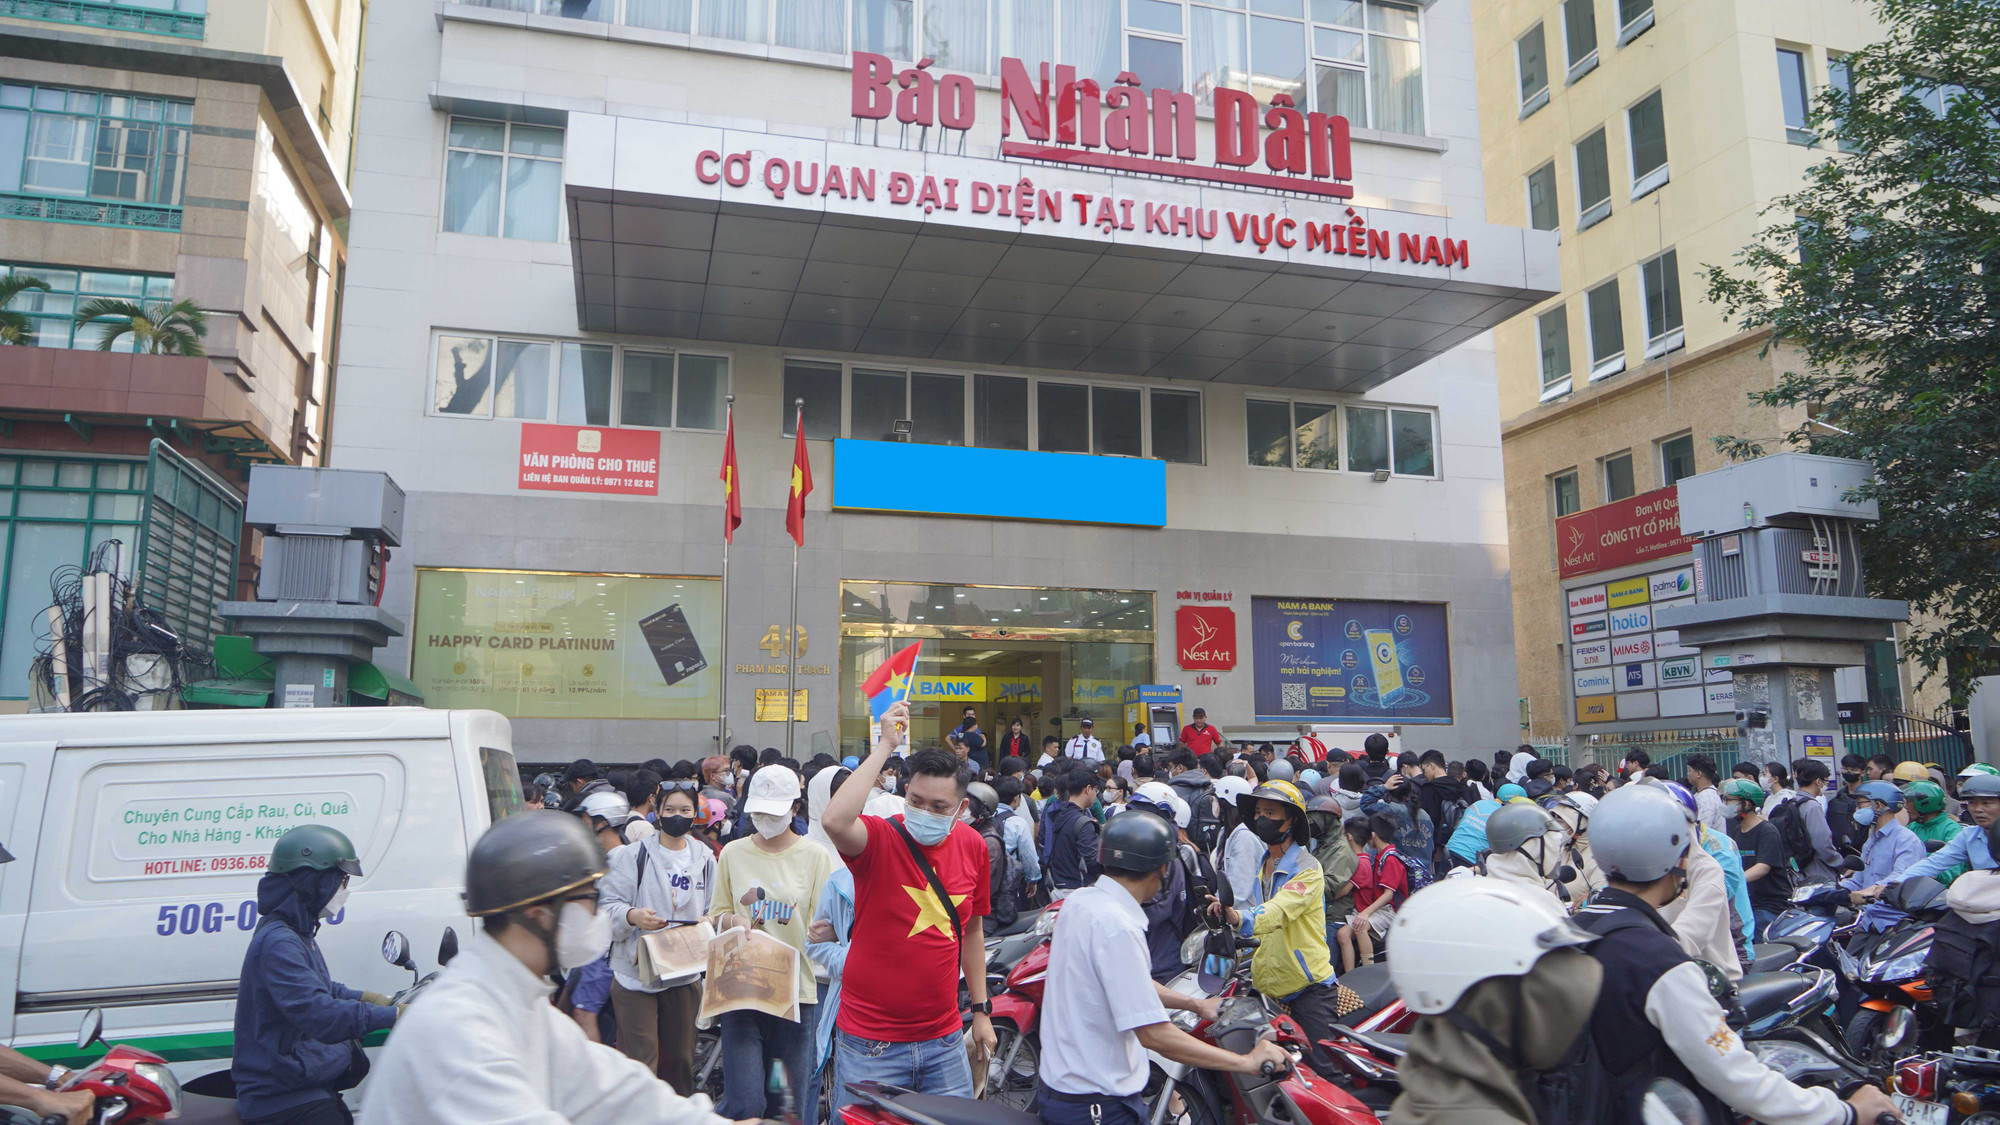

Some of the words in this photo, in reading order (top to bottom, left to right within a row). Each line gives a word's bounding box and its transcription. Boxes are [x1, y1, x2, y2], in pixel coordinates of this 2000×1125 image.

[852, 51, 975, 130] Báo
[1001, 57, 1196, 160] Nhân
[1214, 87, 1352, 181] Dân
[696, 150, 751, 187] CƠ
[764, 158, 875, 202] QUAN
[888, 172, 958, 214] ĐẠI
[971, 177, 1061, 225] DIỆN
[1072, 194, 1135, 234] TẠI
[1145, 202, 1218, 239] KHU
[1227, 211, 1297, 253] VỰC
[1306, 207, 1390, 259] MIỀN
[1399, 232, 1469, 268] NAM
[523, 452, 548, 467] VĂN
[552, 453, 594, 470] PHÒNG
[598, 458, 622, 471] CHO
[626, 459, 656, 473] THUÊ
[523, 472, 540, 482] LIÊN
[541, 473, 551, 484] HỆ
[553, 474, 568, 483] BAN
[570, 474, 590, 485] QUẢN
[592, 474, 603, 485] LÝ:
[604, 477, 621, 486] 0971
[624, 479, 632, 487] 12
[634, 479, 643, 488] 82
[645, 480, 654, 488] 82
[1635, 504, 1653, 517] Đơn
[1653, 501, 1662, 514] Vị
[1600, 529, 1628, 547] CÔNG
[1629, 525, 1641, 539] TY
[1643, 516, 1657, 536] CỔ
[1650, 541, 1668, 551] Hotline
[1564, 556, 1582, 568] Nest
[1583, 552, 1595, 563] Art
[1629, 587, 1645, 595] BANK
[1653, 579, 1677, 596] palma
[1176, 590, 1191, 600] ĐƠN
[1193, 591, 1201, 602] VỊ
[1203, 589, 1222, 601] QUẢN
[1278, 602, 1300, 610] NAM
[1301, 602, 1308, 610] A
[1309, 603, 1334, 611] BANK
[1612, 613, 1648, 631] hoiio
[429, 634, 484, 649] HAPPY
[488, 636, 533, 650] CARD
[539, 637, 615, 651] PLATINUM
[759, 625, 808, 659] 40
[1183, 648, 1209, 661] Nest
[1211, 649, 1230, 661] Art
[1613, 643, 1640, 656] MIMS
[736, 664, 764, 675] PHẠM
[768, 664, 790, 676] NGỌ
[797, 665, 830, 676] THẠCH
[1281, 667, 1295, 676] mọi
[1297, 666, 1309, 675] trải
[1311, 667, 1342, 677] nghiệm!
[1628, 670, 1642, 680] ATS
[1664, 665, 1690, 678] KBVN
[1213, 676, 1218, 685] 7
[1577, 675, 1610, 688] Cominix
[920, 682, 974, 695] BANK
[1126, 688, 1138, 702] ATM
[124, 809, 179, 826] Chuyên
[184, 808, 222, 823] Cung
[226, 803, 254, 822] Cấp
[257, 804, 289, 819] Rau,
[294, 803, 316, 817] Củ,
[321, 801, 349, 815] Quả
[138, 831, 167, 845] Cho
[172, 828, 200, 843] Nhà
[204, 828, 241, 844] Hàng
[255, 825, 293, 840] Khác
[144, 860, 206, 875] HOTLINE:
